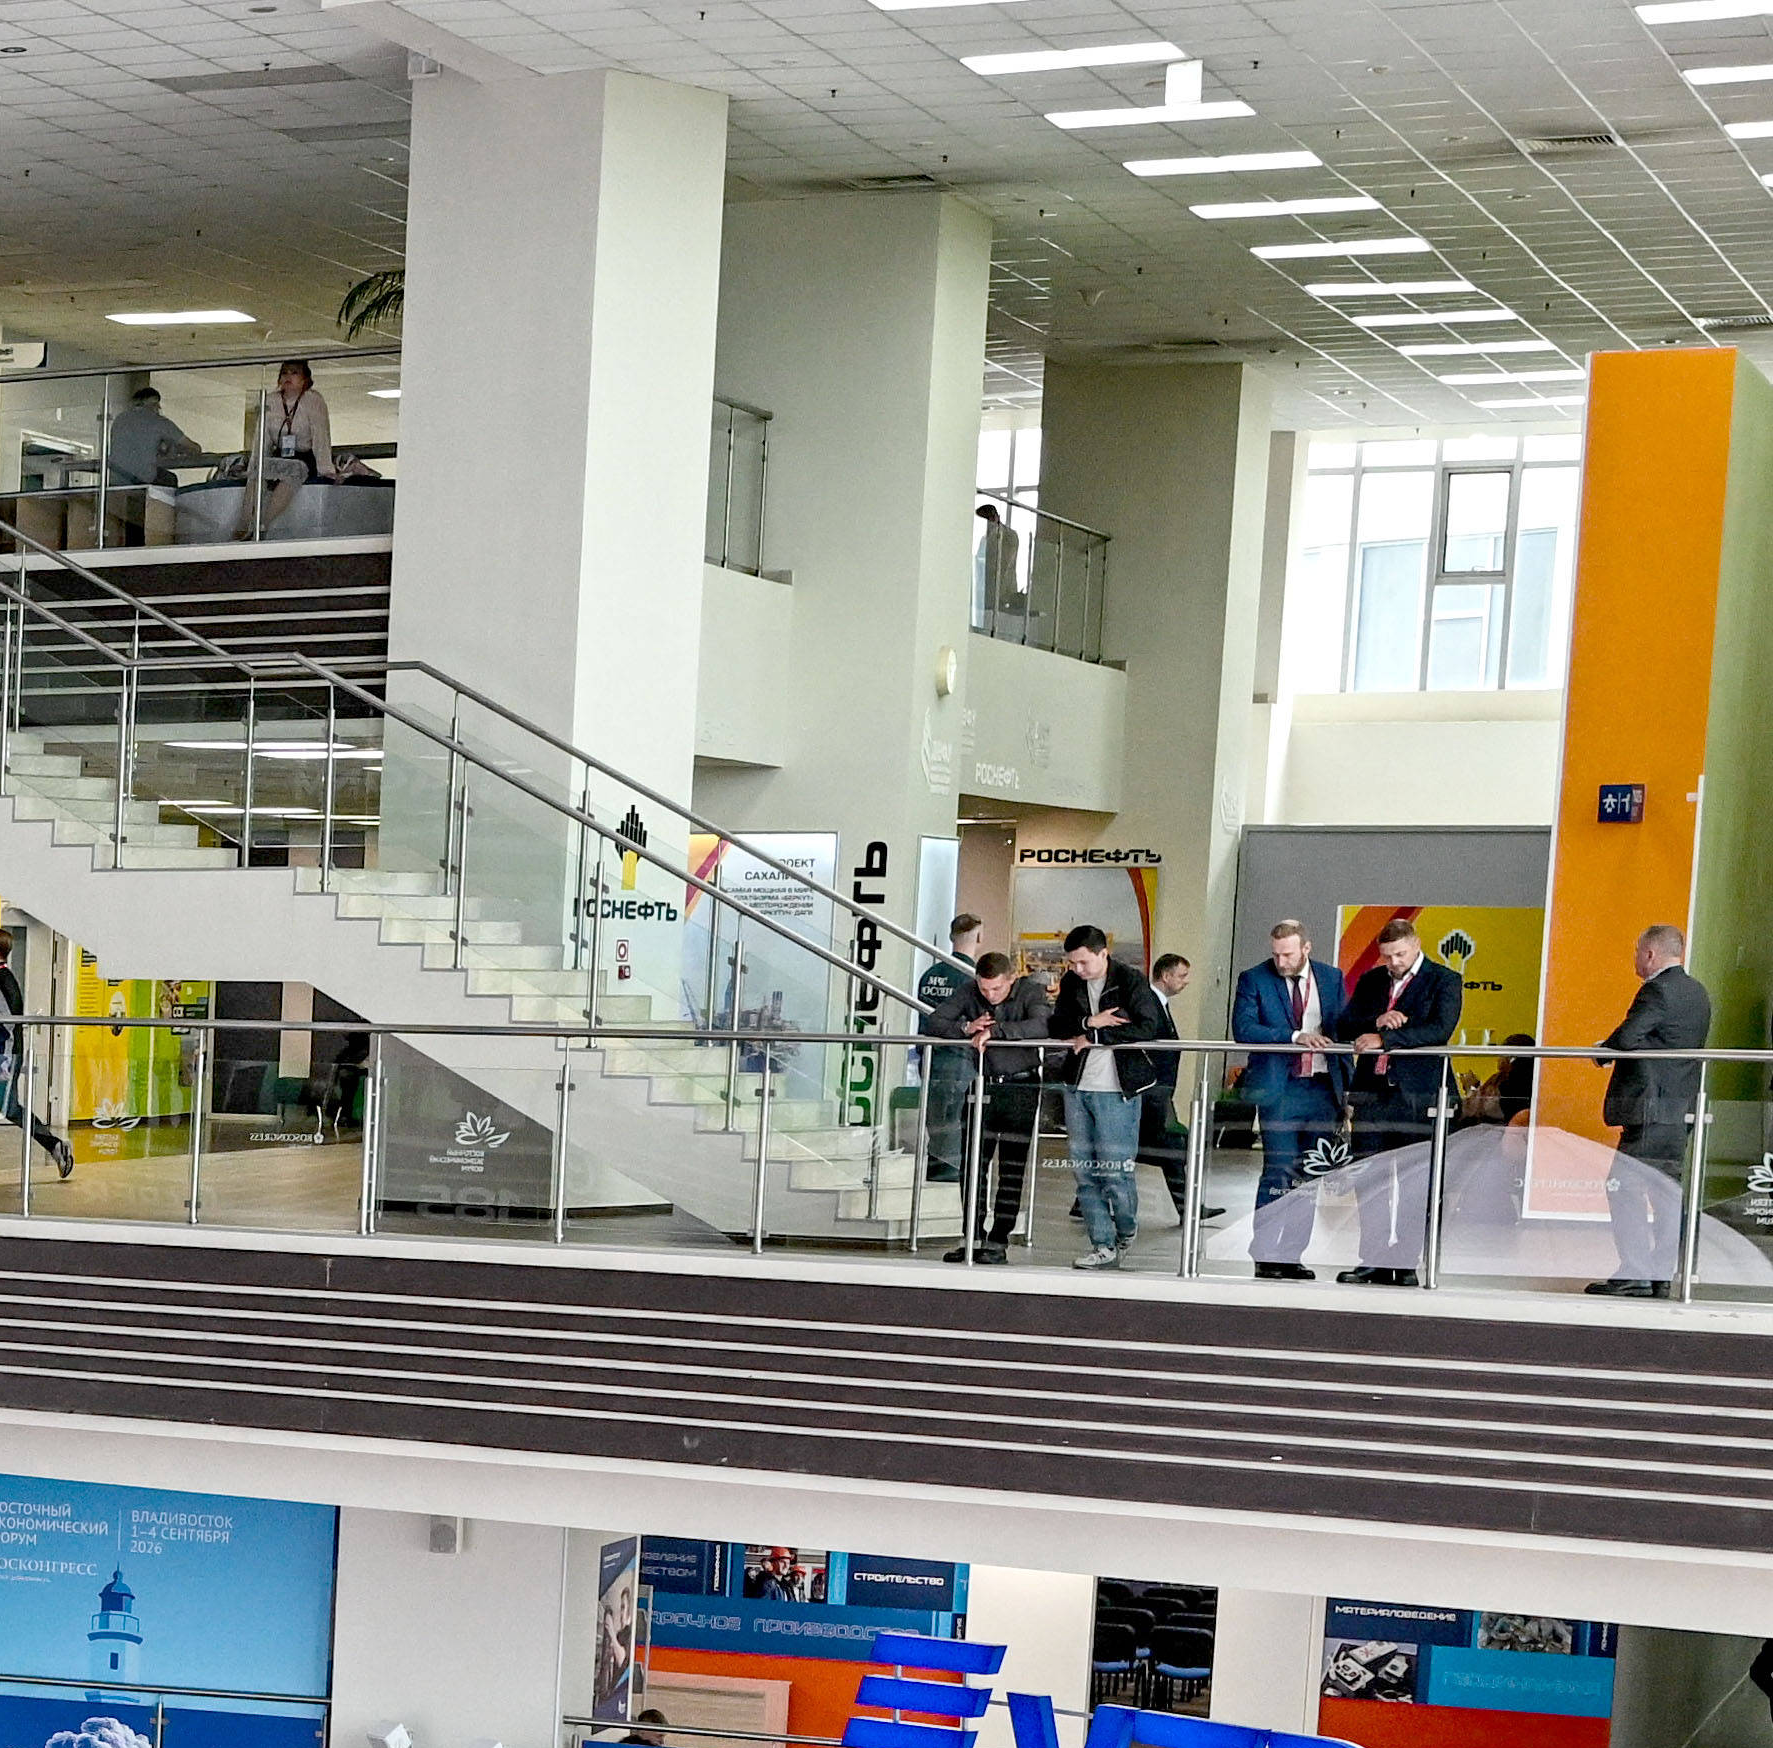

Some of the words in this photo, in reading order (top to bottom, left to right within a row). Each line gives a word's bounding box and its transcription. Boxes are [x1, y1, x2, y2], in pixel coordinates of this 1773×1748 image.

[1019, 848, 1162, 864] РОСНЕФТЬ
[131, 1509, 235, 1531] ВЛАДИВОСТОК
[160, 1528, 231, 1545] СЕНТЯБРЯ
[130, 1540, 163, 1556] 2026
[853, 1572, 945, 1588] СТРОИТЕЛЬСТВО
[1335, 1604, 1457, 1625] МАТЕРИАЛОВЕДЕНИЕ
